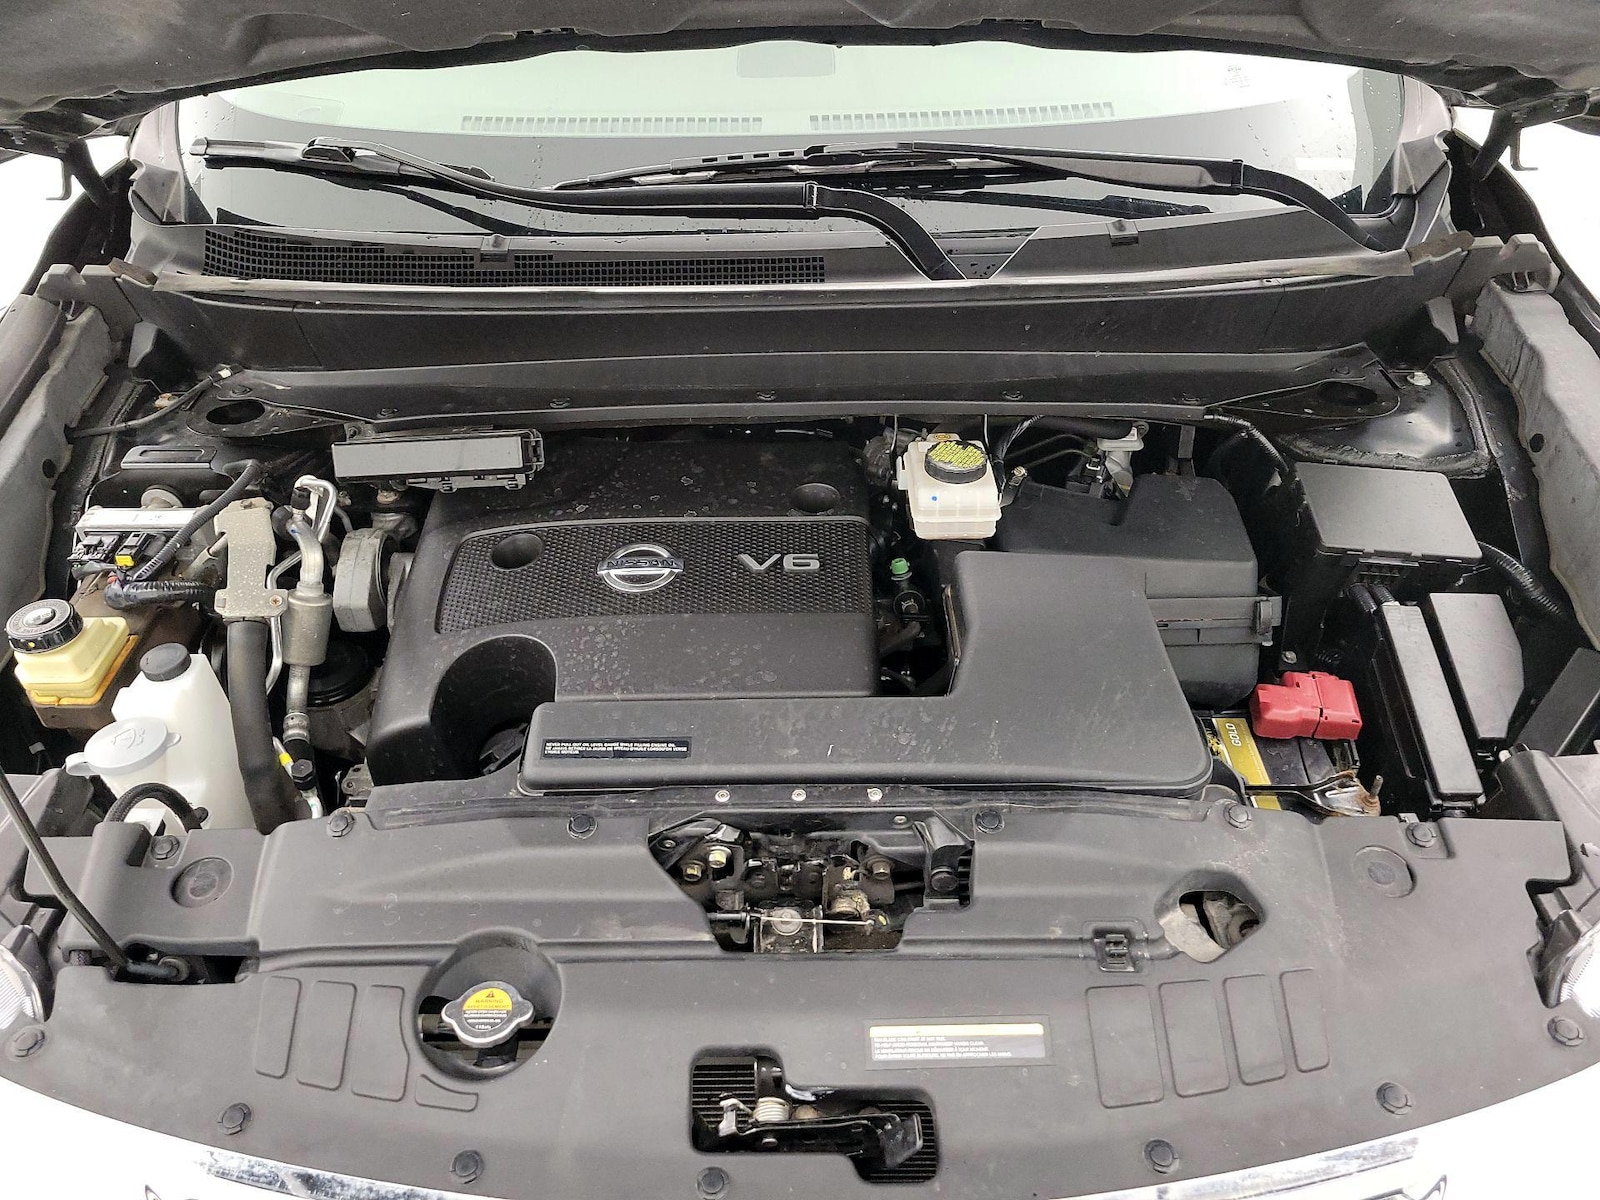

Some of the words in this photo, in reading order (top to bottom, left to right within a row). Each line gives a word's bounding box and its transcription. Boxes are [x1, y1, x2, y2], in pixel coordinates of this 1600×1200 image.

[607, 559, 675, 568] NISSAN
[738, 553, 821, 572] V6
[1225, 723, 1242, 746] GOLD
